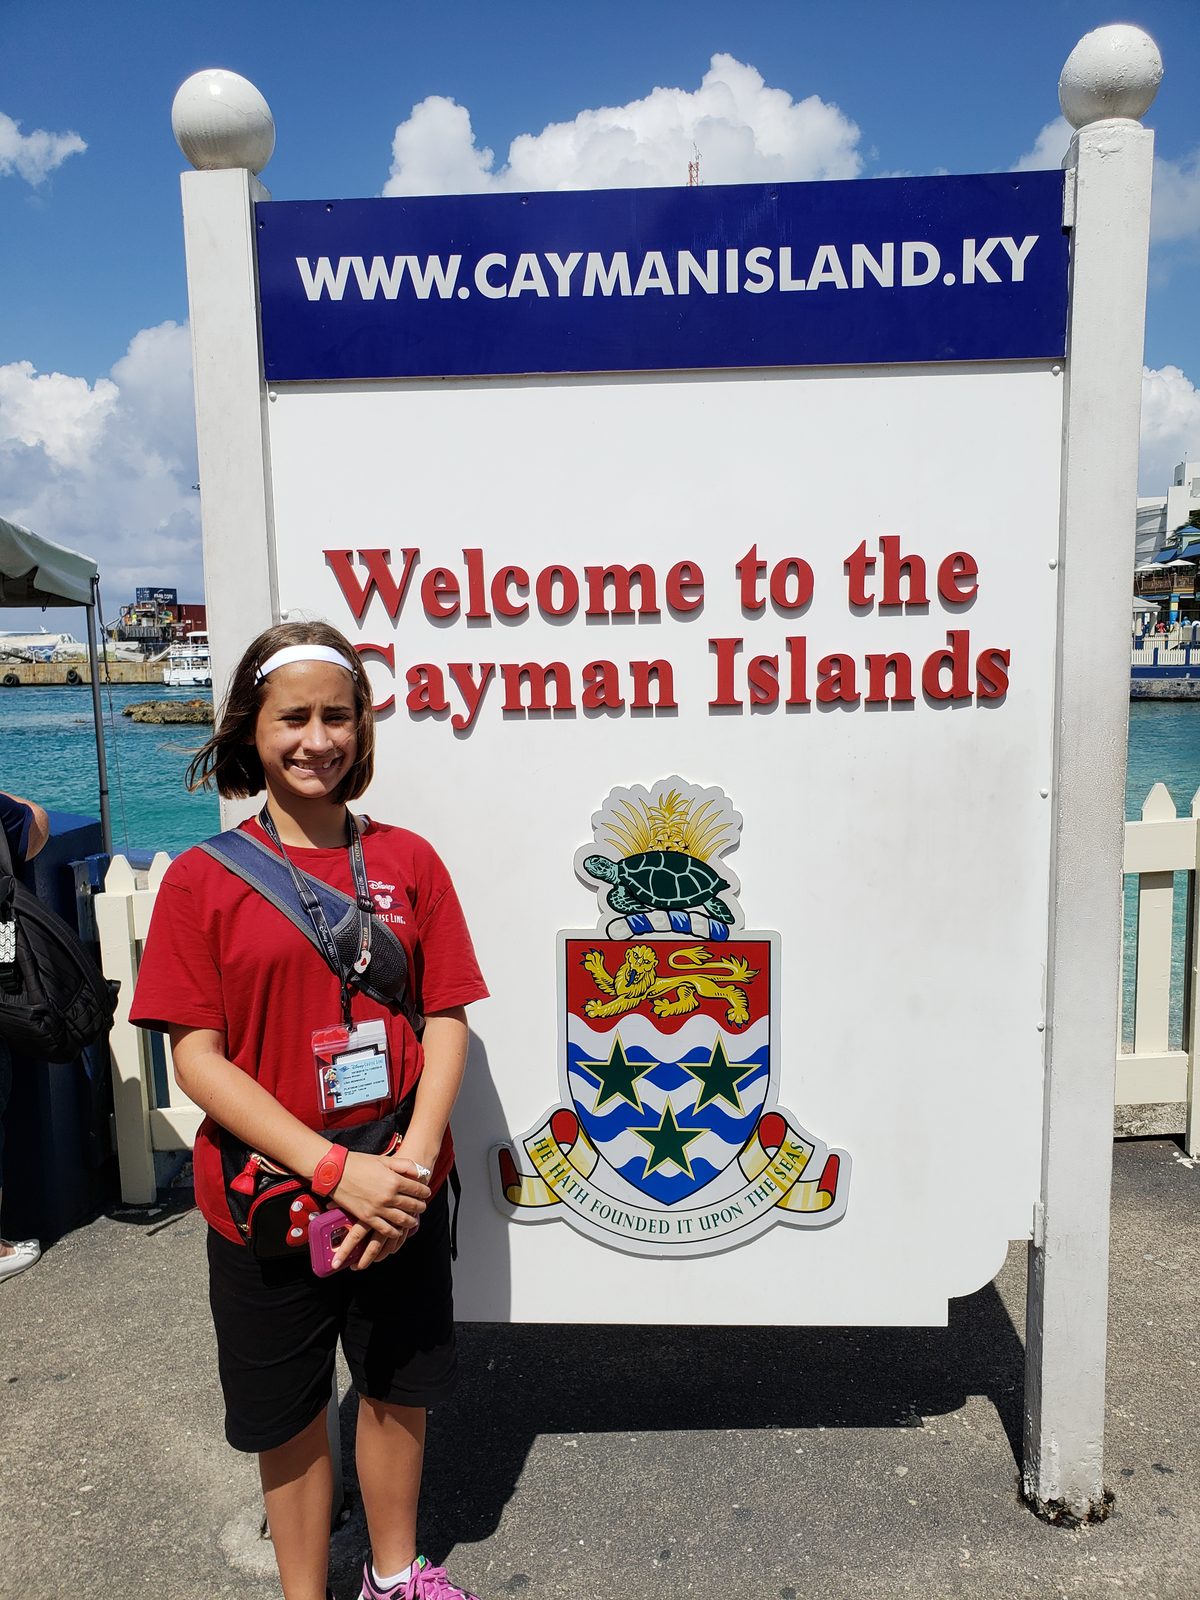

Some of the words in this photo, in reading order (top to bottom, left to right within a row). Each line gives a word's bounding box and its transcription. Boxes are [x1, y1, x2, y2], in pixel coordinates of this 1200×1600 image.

[295, 235, 1039, 302] WWW.CAYMANISLAND.KY
[323, 547, 705, 620] Welcome
[736, 543, 815, 611] to
[843, 535, 979, 606] the
[708, 629, 1011, 706] Islands
[368, 880, 395, 893] Disney
[533, 1136, 555, 1163] HE
[549, 1162, 590, 1205] HATH
[589, 1199, 670, 1235] FOUNDED
[677, 1218, 693, 1234] IT
[698, 1202, 744, 1232] UPON
[744, 1177, 778, 1208] THE
[774, 1141, 805, 1180] SEAS
